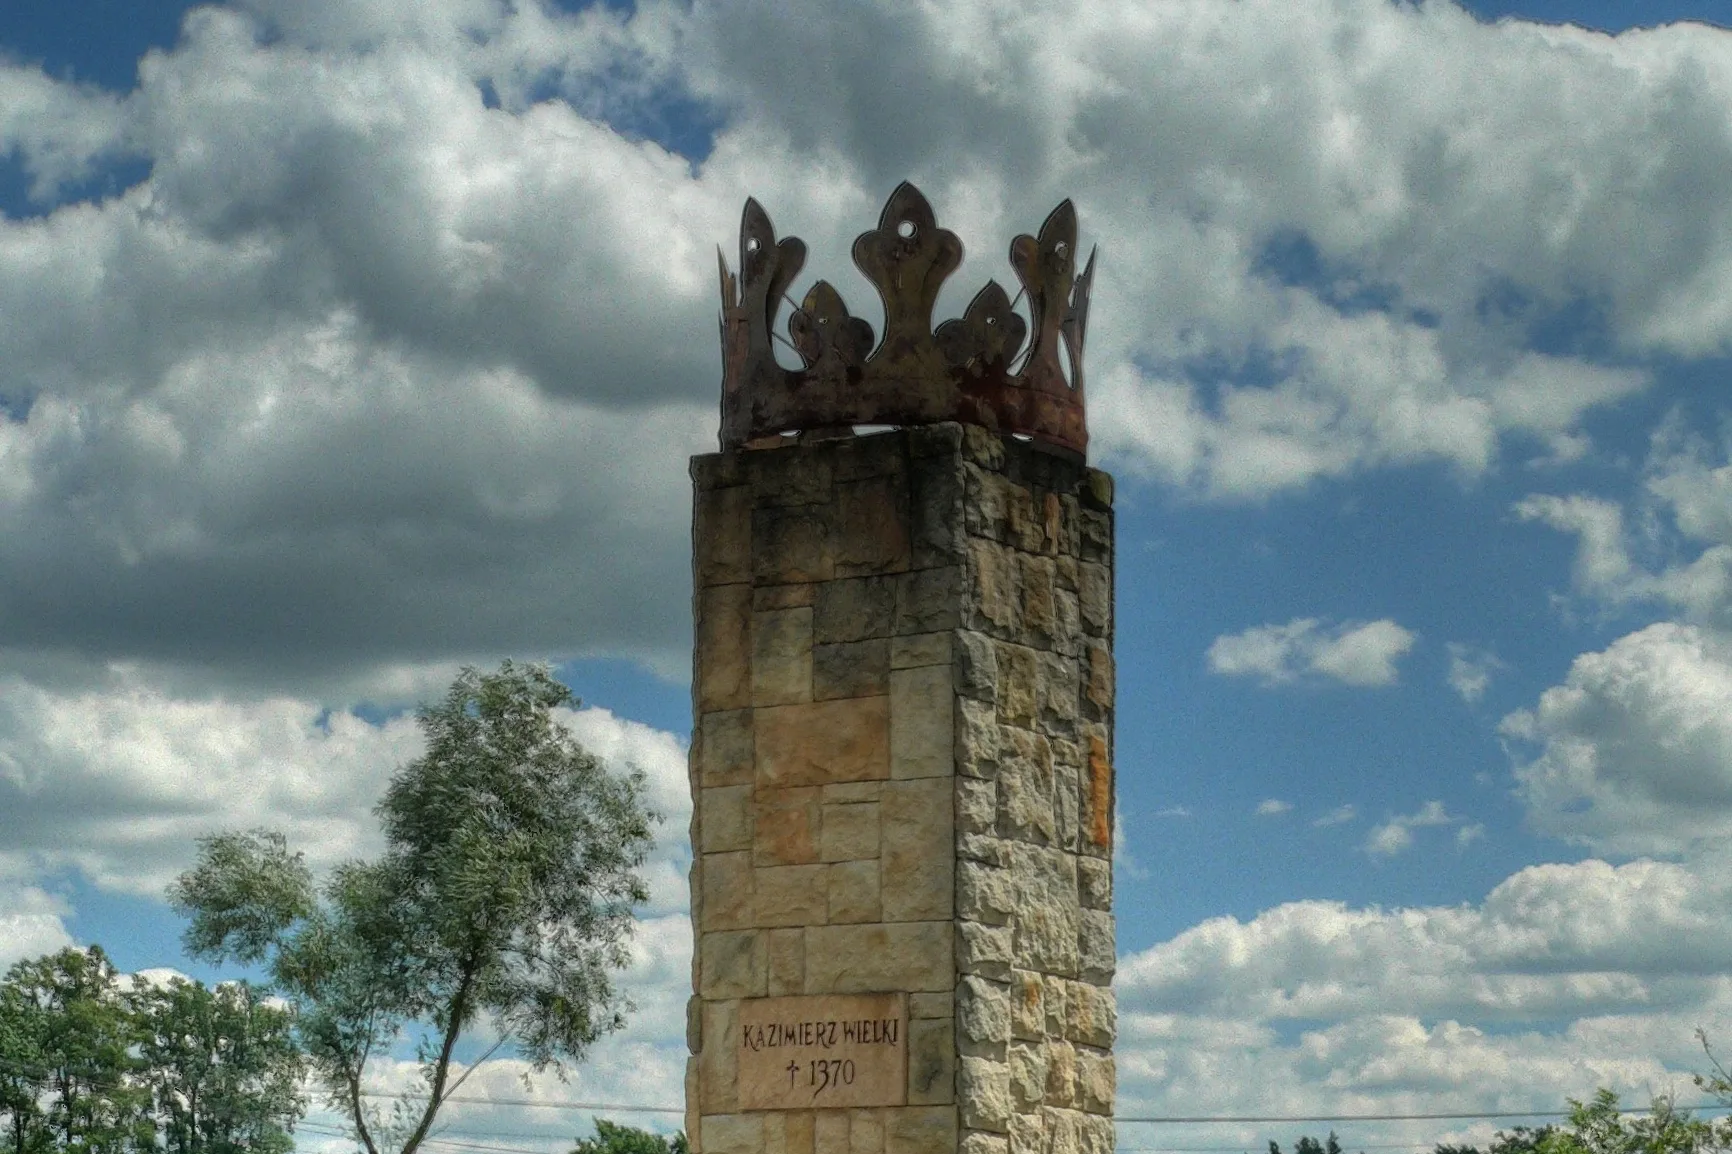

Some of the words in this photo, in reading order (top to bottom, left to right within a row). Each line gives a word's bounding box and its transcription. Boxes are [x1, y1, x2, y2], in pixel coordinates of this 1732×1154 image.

[743, 1021, 837, 1051] KAZIMIERZ
[842, 1019, 899, 1047] WIELKI
[810, 1059, 856, 1099] 1370
